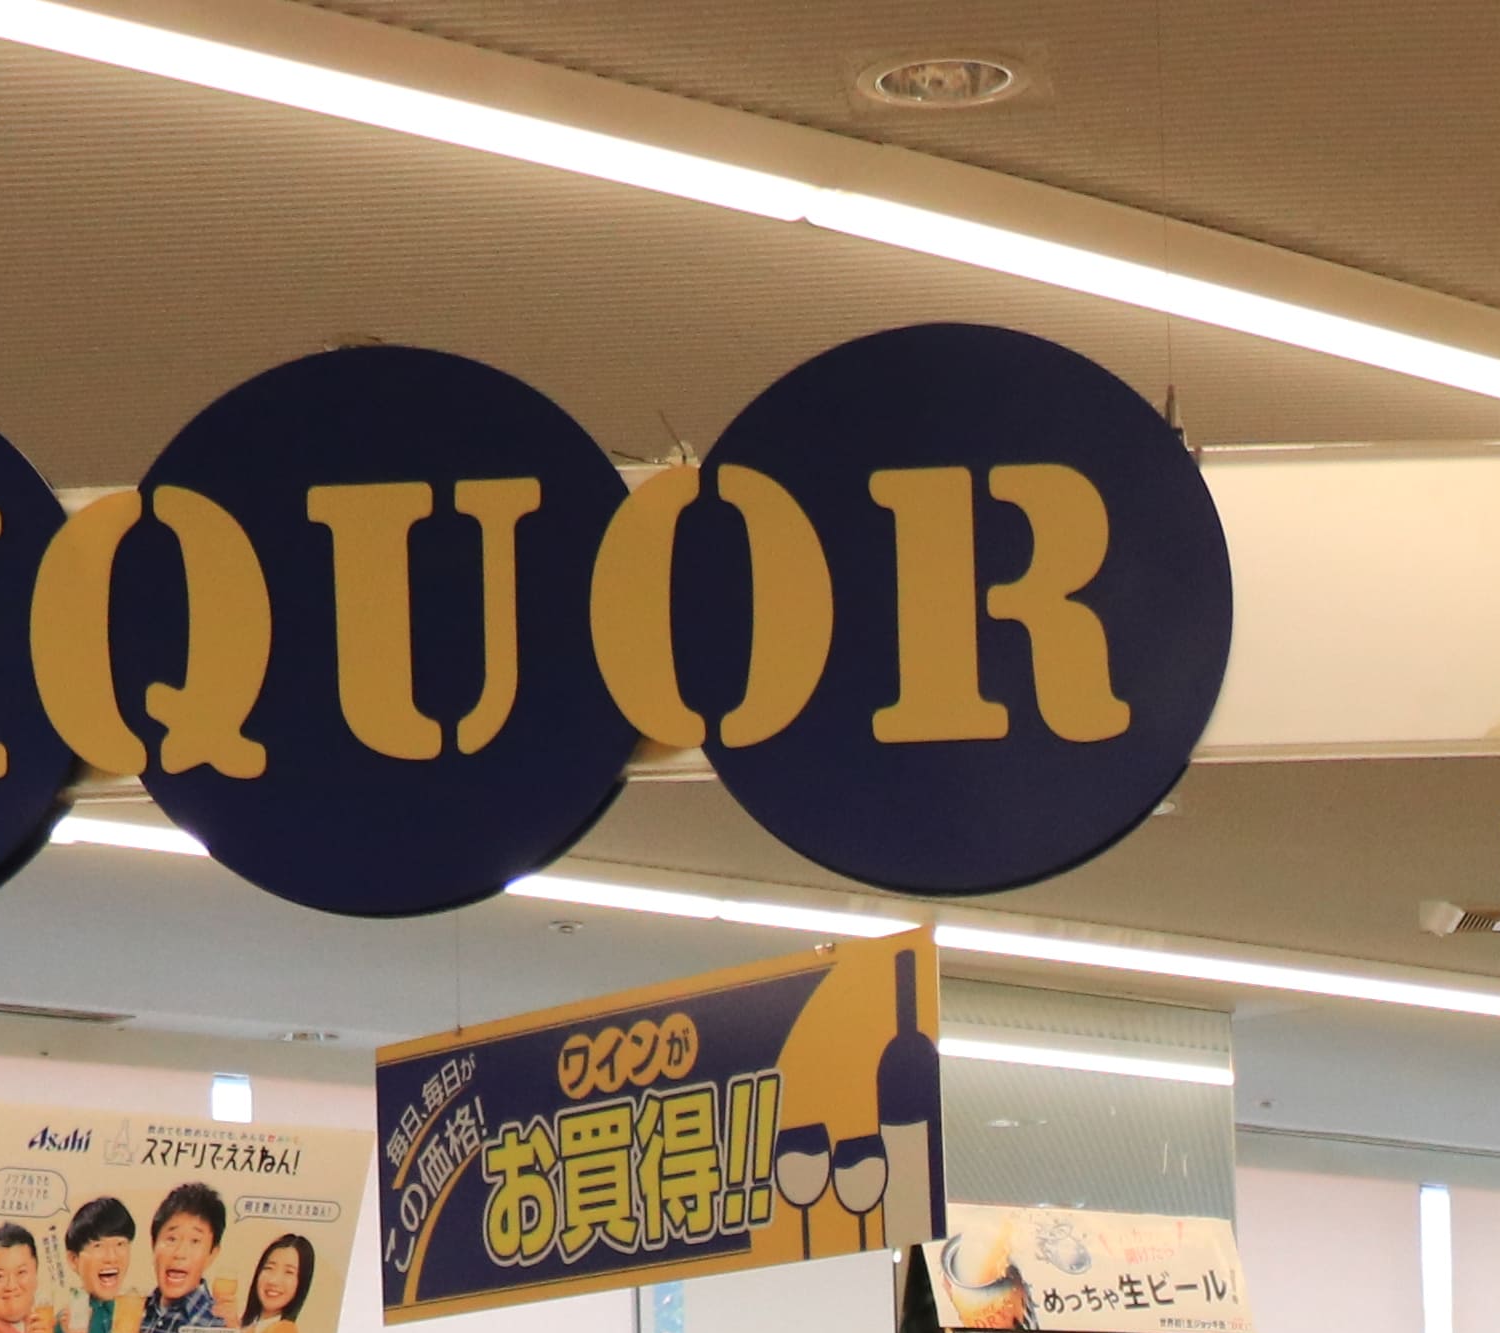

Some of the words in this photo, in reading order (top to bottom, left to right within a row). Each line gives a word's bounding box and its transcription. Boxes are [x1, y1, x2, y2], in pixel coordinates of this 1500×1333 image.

[562, 1027, 691, 1085] ワインが
[386, 1051, 476, 1165] 毎日、毎日が
[28, 1126, 92, 1153] Asahi
